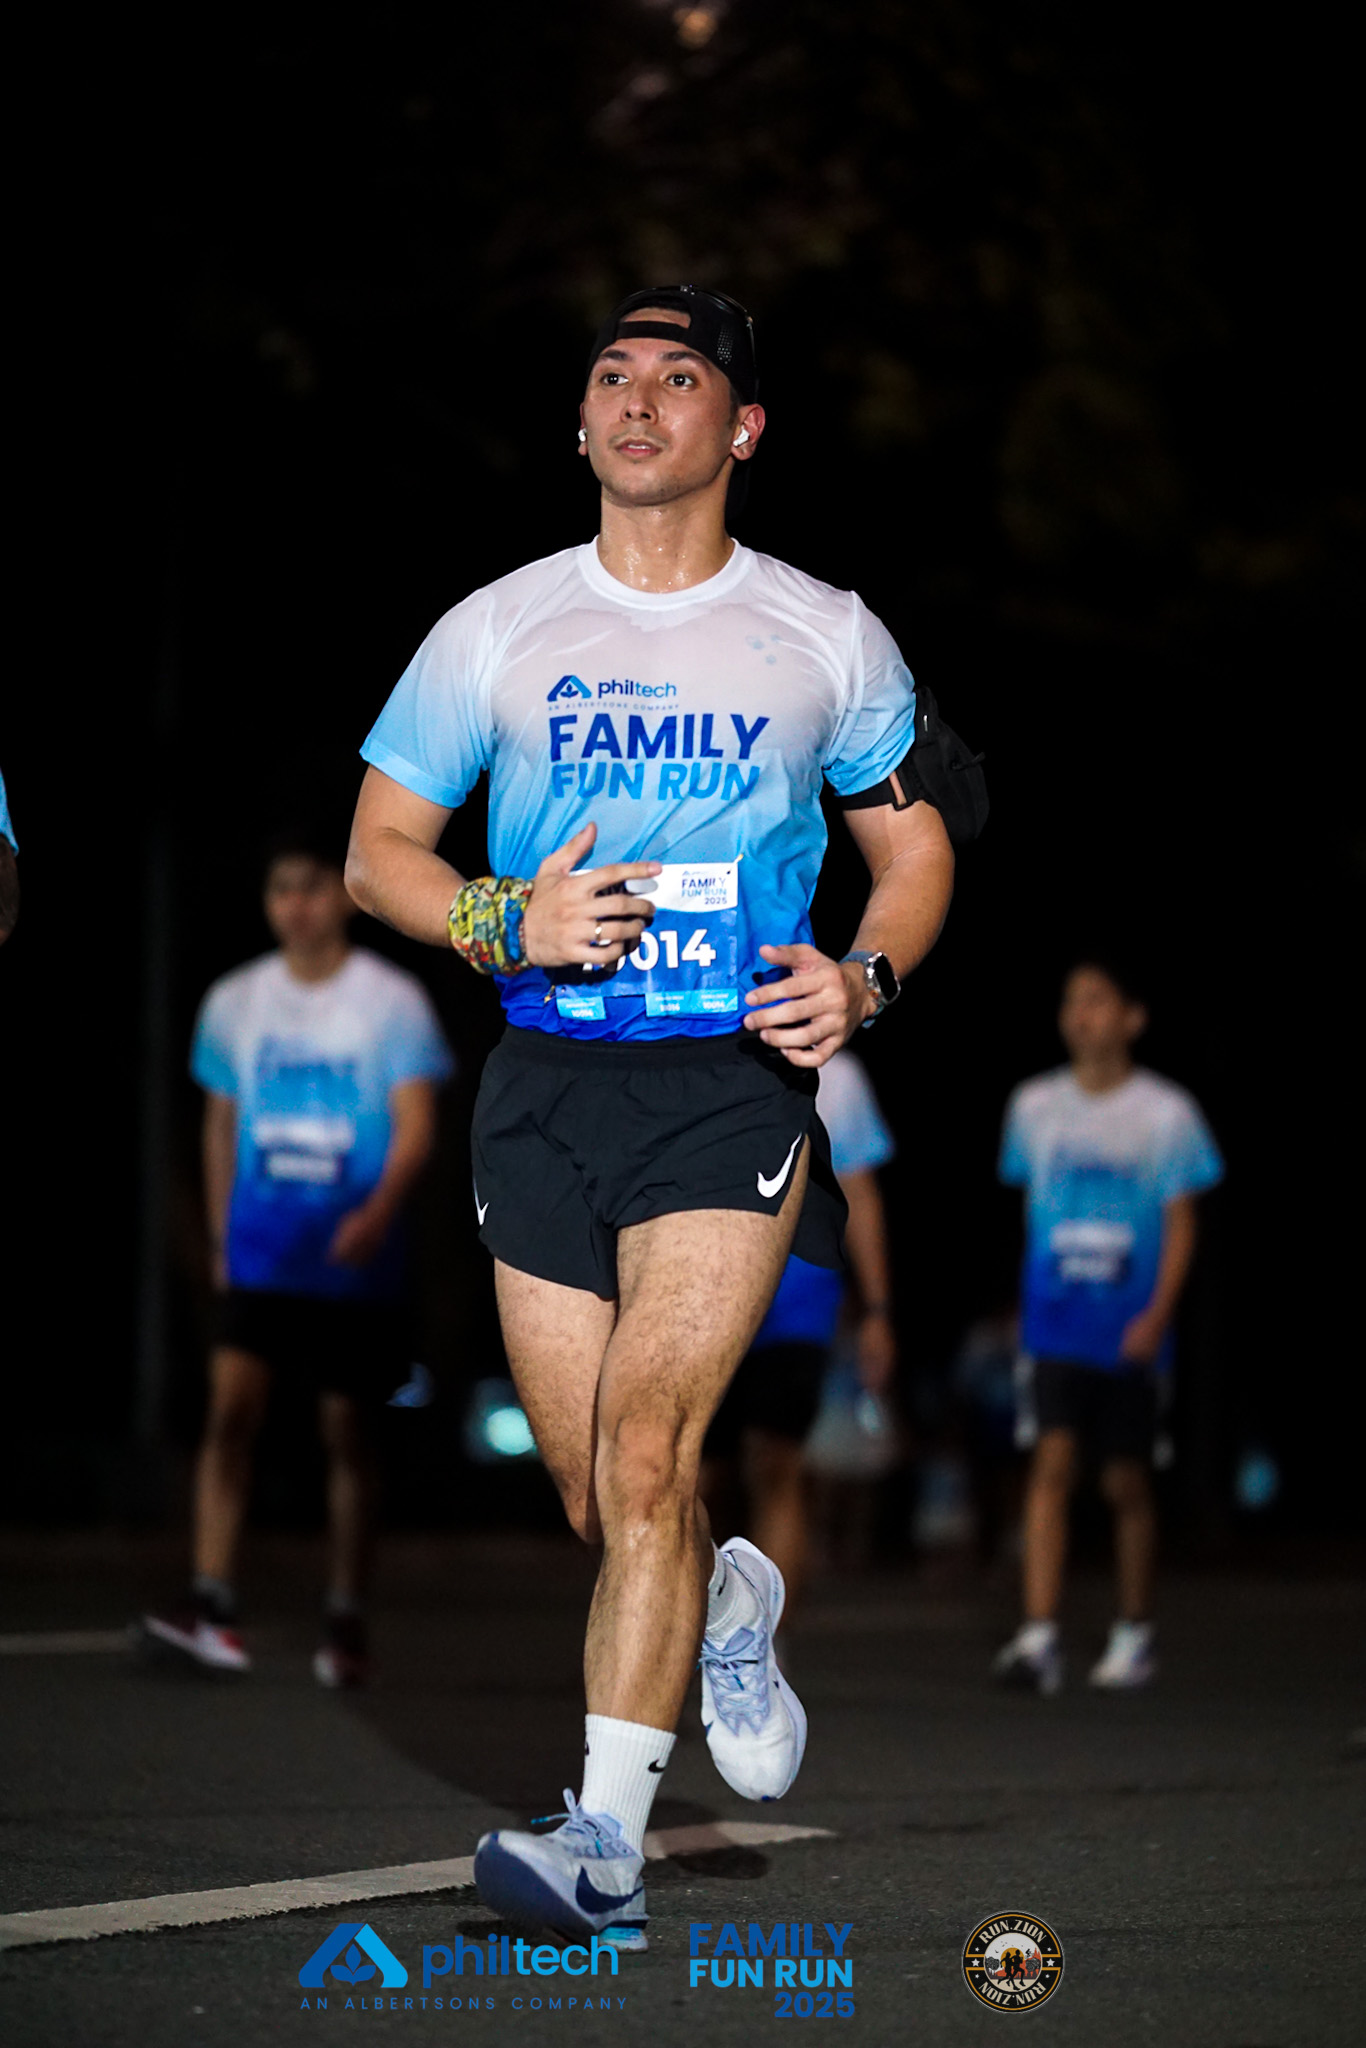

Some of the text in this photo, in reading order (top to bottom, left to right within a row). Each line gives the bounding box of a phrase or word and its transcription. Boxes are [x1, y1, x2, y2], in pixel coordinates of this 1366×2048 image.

[598, 679, 677, 698] philtech
[549, 713, 770, 762] FAMILY
[552, 761, 760, 801] FUN RUN
[681, 877, 727, 888] FAMILY
[681, 888, 727, 897] FUN RUN
[704, 897, 727, 905] 2025
[583, 929, 716, 971] 014
